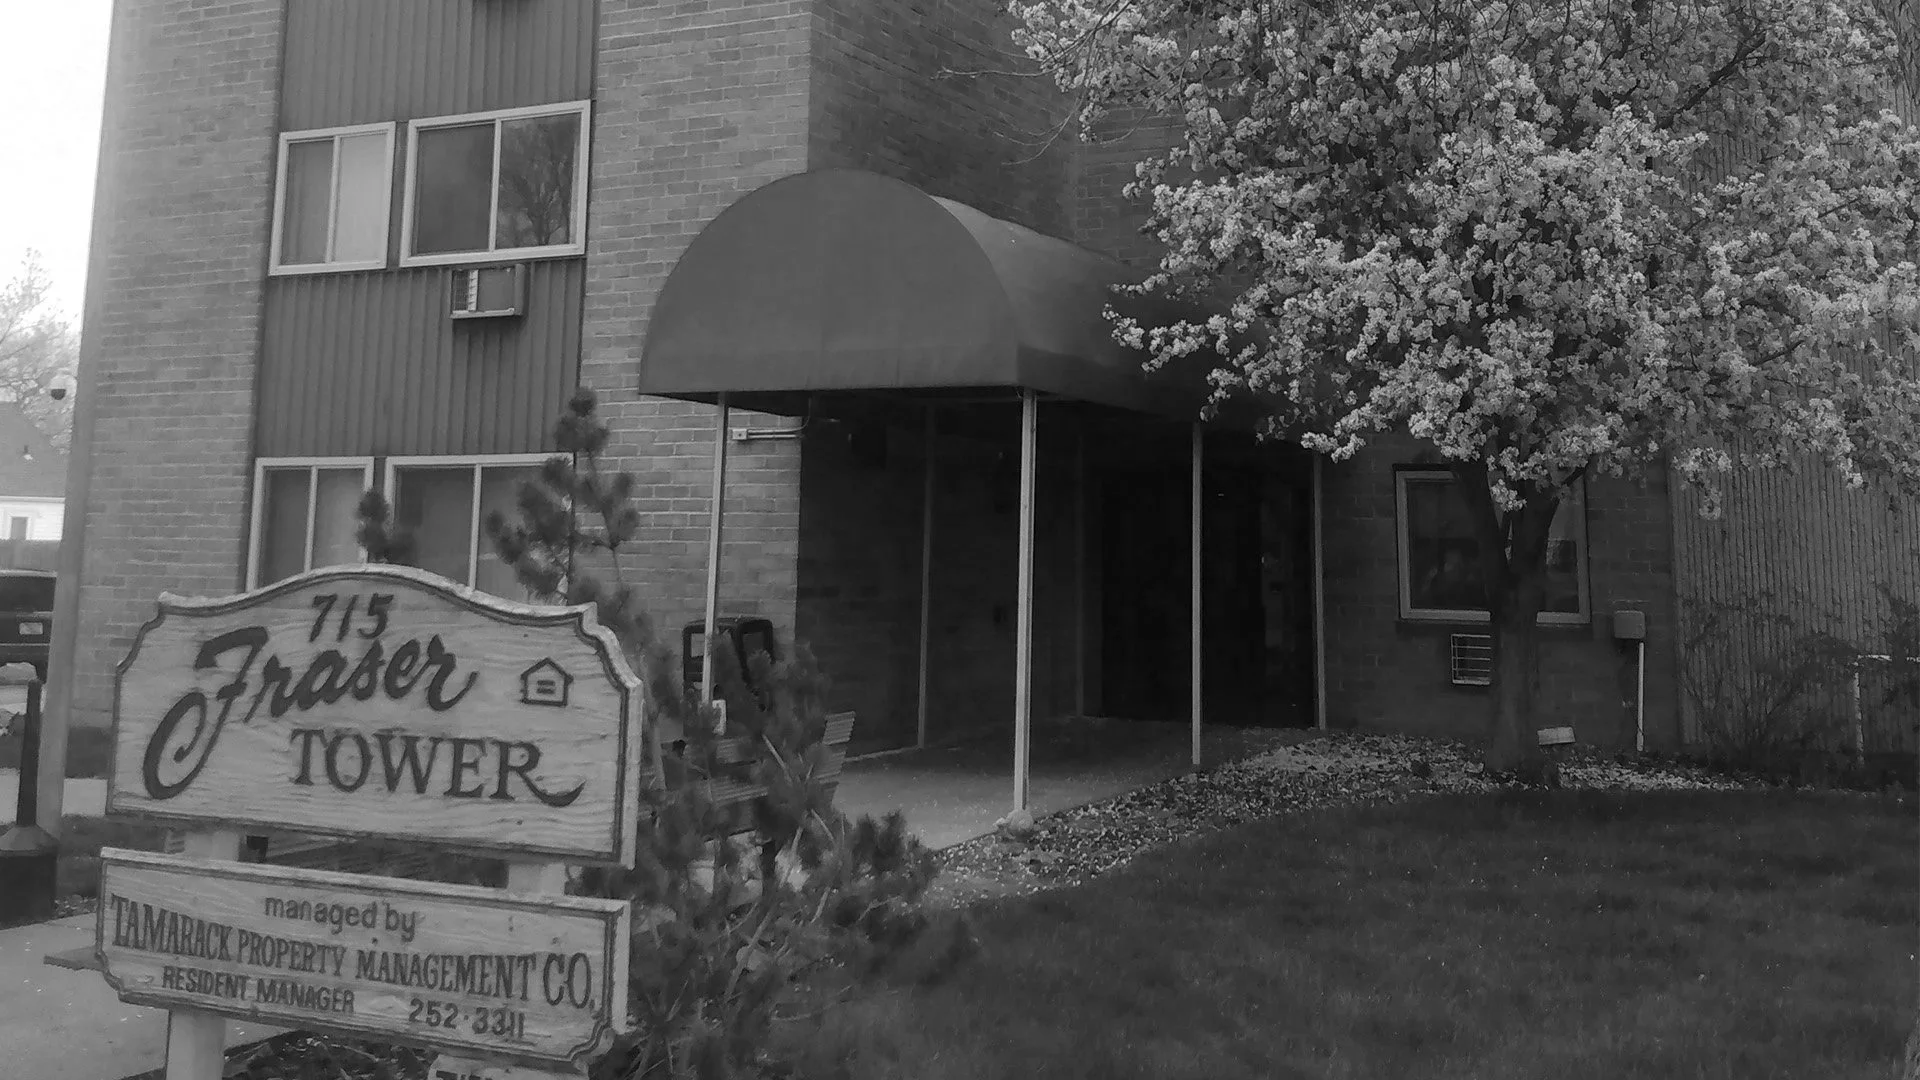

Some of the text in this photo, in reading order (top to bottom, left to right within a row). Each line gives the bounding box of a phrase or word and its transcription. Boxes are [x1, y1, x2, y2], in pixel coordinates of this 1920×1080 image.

[311, 594, 393, 642] 715
[143, 626, 478, 799] Fraser
[290, 728, 585, 807] TOWER
[111, 893, 233, 962] TAMARACK
[237, 928, 347, 976] PROPERTY
[355, 949, 536, 1000] MANAGEMENT
[265, 897, 416, 942] managed by
[162, 965, 354, 1013] RESIDENT MANAGER
